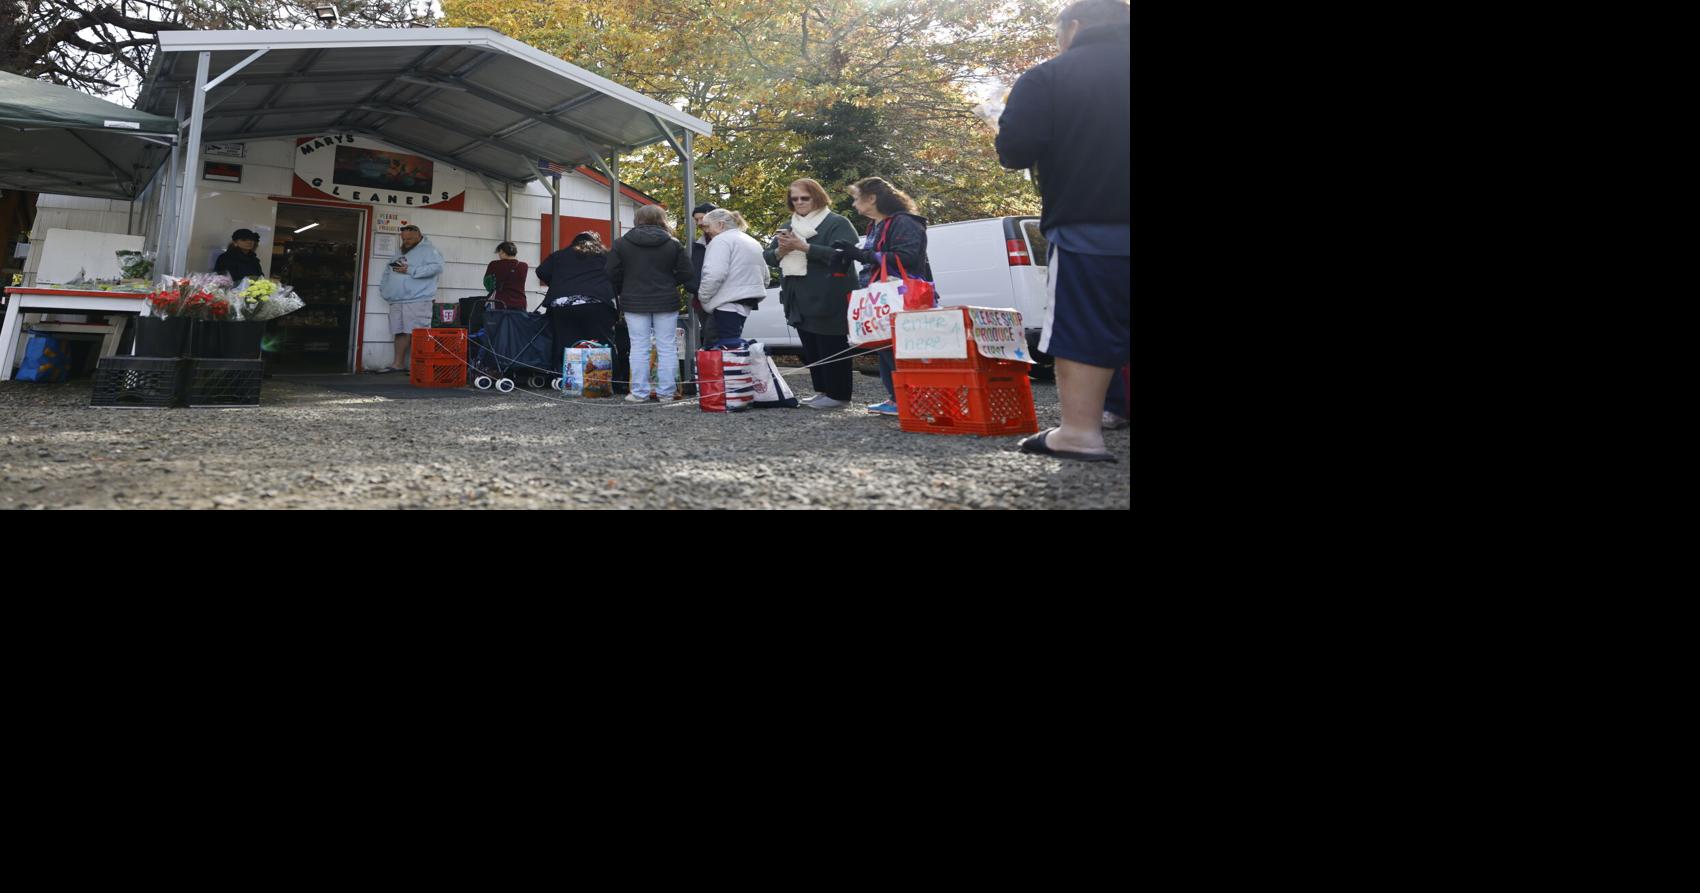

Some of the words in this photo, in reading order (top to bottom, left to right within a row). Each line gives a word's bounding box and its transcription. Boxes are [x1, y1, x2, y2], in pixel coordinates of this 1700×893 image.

[300, 134, 354, 155] MARYS
[312, 177, 449, 205] GLEANERS
[859, 291, 887, 310] LVE
[970, 309, 1002, 326] PLEASE
[1001, 311, 1023, 327] SHOP
[975, 326, 1016, 342] PRODUCE
